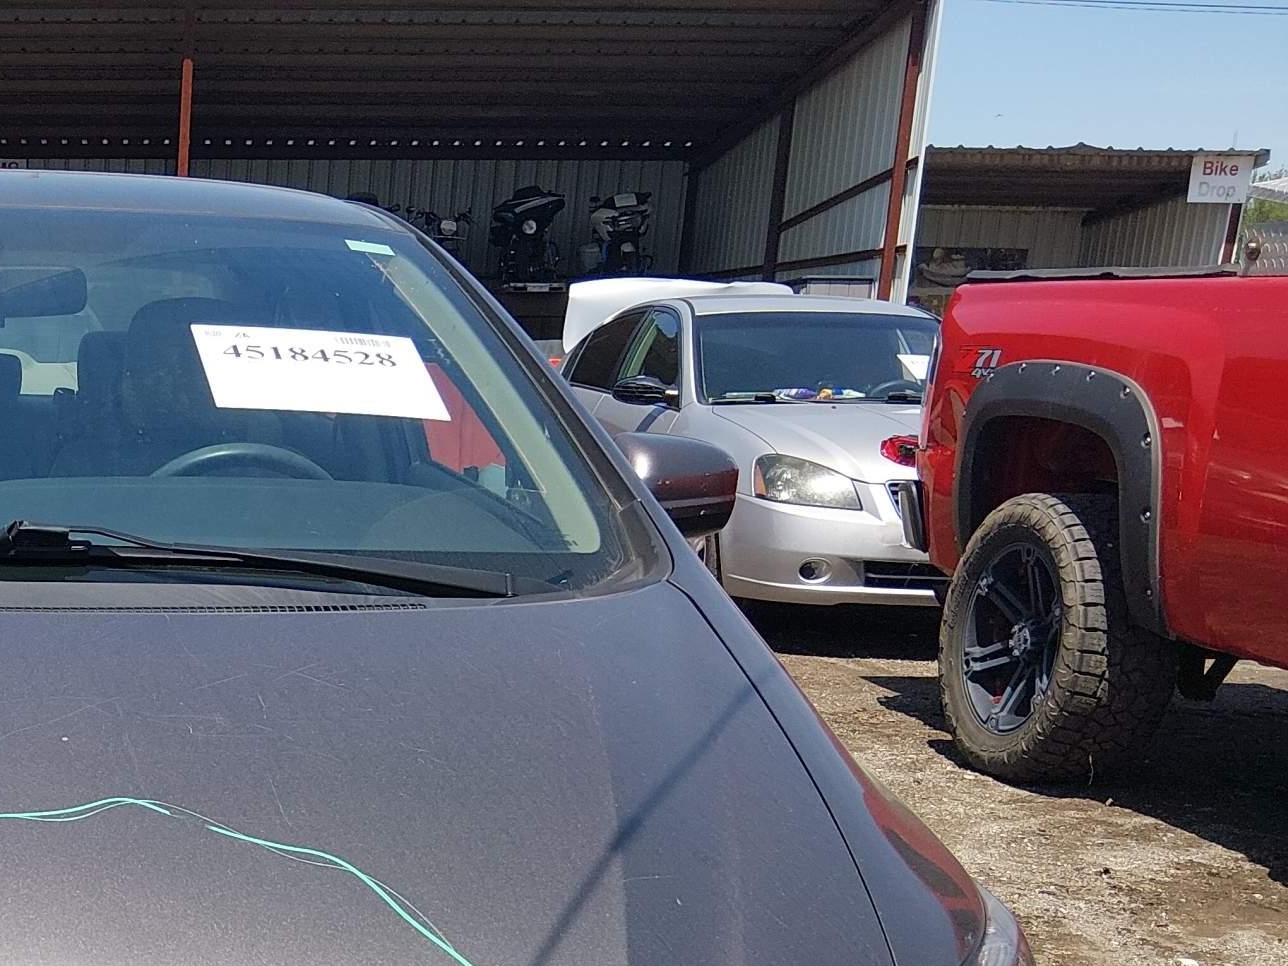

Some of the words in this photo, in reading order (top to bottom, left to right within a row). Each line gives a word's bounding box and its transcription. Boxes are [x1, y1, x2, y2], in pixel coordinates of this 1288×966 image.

[1202, 160, 1239, 176] Bike
[1198, 182, 1236, 200] Drop
[223, 344, 396, 367] 45184528
